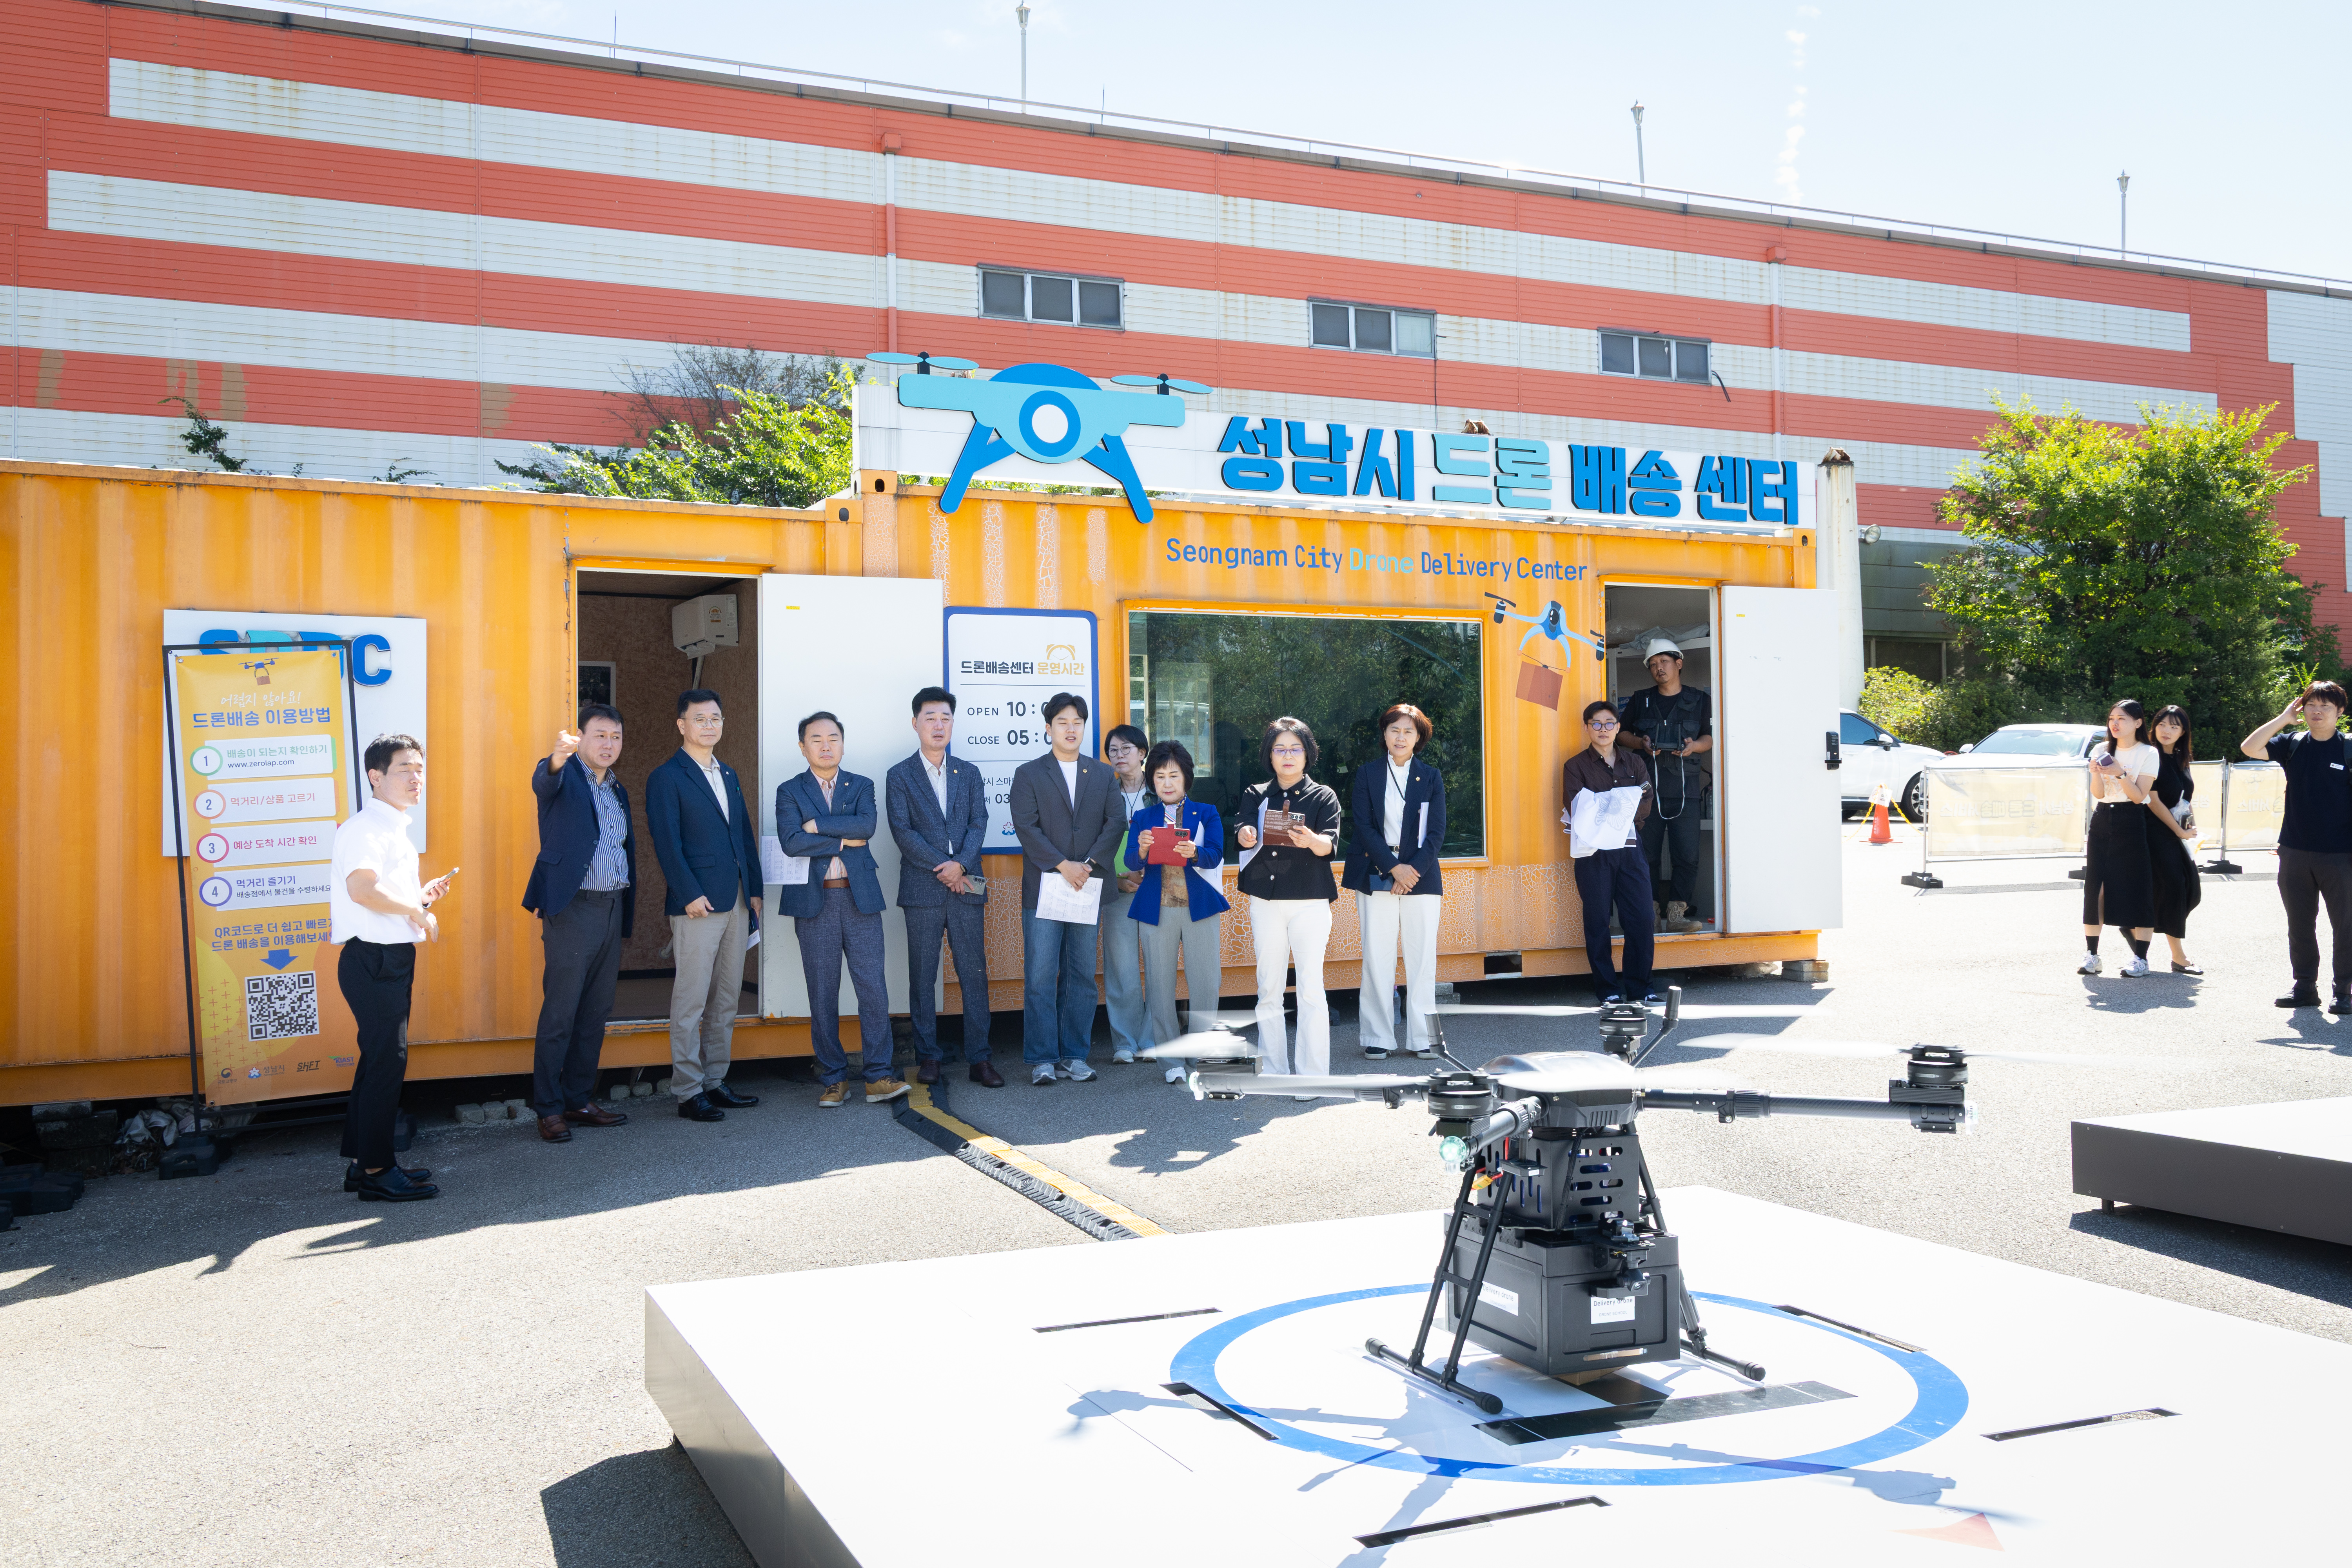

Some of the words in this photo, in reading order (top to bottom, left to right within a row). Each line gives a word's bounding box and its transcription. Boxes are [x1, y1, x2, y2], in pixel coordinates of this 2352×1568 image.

[1218, 416, 1415, 501] 성남시
[1432, 432, 1552, 510] 드론
[1568, 443, 1682, 519] 배송
[1694, 455, 1798, 525] 센터
[1166, 537, 1288, 569] Seongnam
[1295, 544, 1343, 573] City
[1349, 548, 1414, 573] Drone
[1421, 551, 1512, 582] Delivery
[1516, 557, 1588, 581] Center
[961, 661, 1033, 674] 드론배송센터
[1037, 662, 1085, 675] 운영시간
[221, 693, 256, 708] 어렵지
[263, 691, 301, 706] 않아요!
[193, 710, 259, 728] 드론배송
[266, 707, 330, 724] 이용방법
[968, 736, 999, 744] CLOSE
[227, 748, 256, 758] 배송이
[259, 746, 287, 757] 되는지
[290, 745, 327, 755] 확인하기
[203, 755, 208, 766] 1
[228, 759, 294, 768] www.zerolap.com
[996, 777, 1014, 786] 스마
[206, 799, 212, 810] 2
[230, 795, 284, 806] 먹거리/상품
[287, 793, 315, 803] 고르기
[209, 843, 215, 854] 3
[234, 840, 252, 850] 예상
[256, 838, 274, 848] 도착
[277, 837, 296, 847] 시간
[298, 836, 317, 845] 확인
[236, 878, 265, 888] 먹거리
[268, 875, 296, 886] 즐기기
[212, 886, 218, 897] 4
[237, 889, 272, 898] 배송점에서
[274, 887, 295, 896] 물건을
[297, 885, 331, 893] 수령하세요
[215, 924, 263, 938] QR코드로
[267, 922, 278, 933] 더
[281, 921, 303, 932] 쉽고
[212, 940, 233, 952] 드론
[237, 936, 270, 949] 배송을
[263, 1065, 285, 1073] 성남시
[1483, 1284, 1500, 1298] Delivery
[1501, 1291, 1514, 1301] drone
